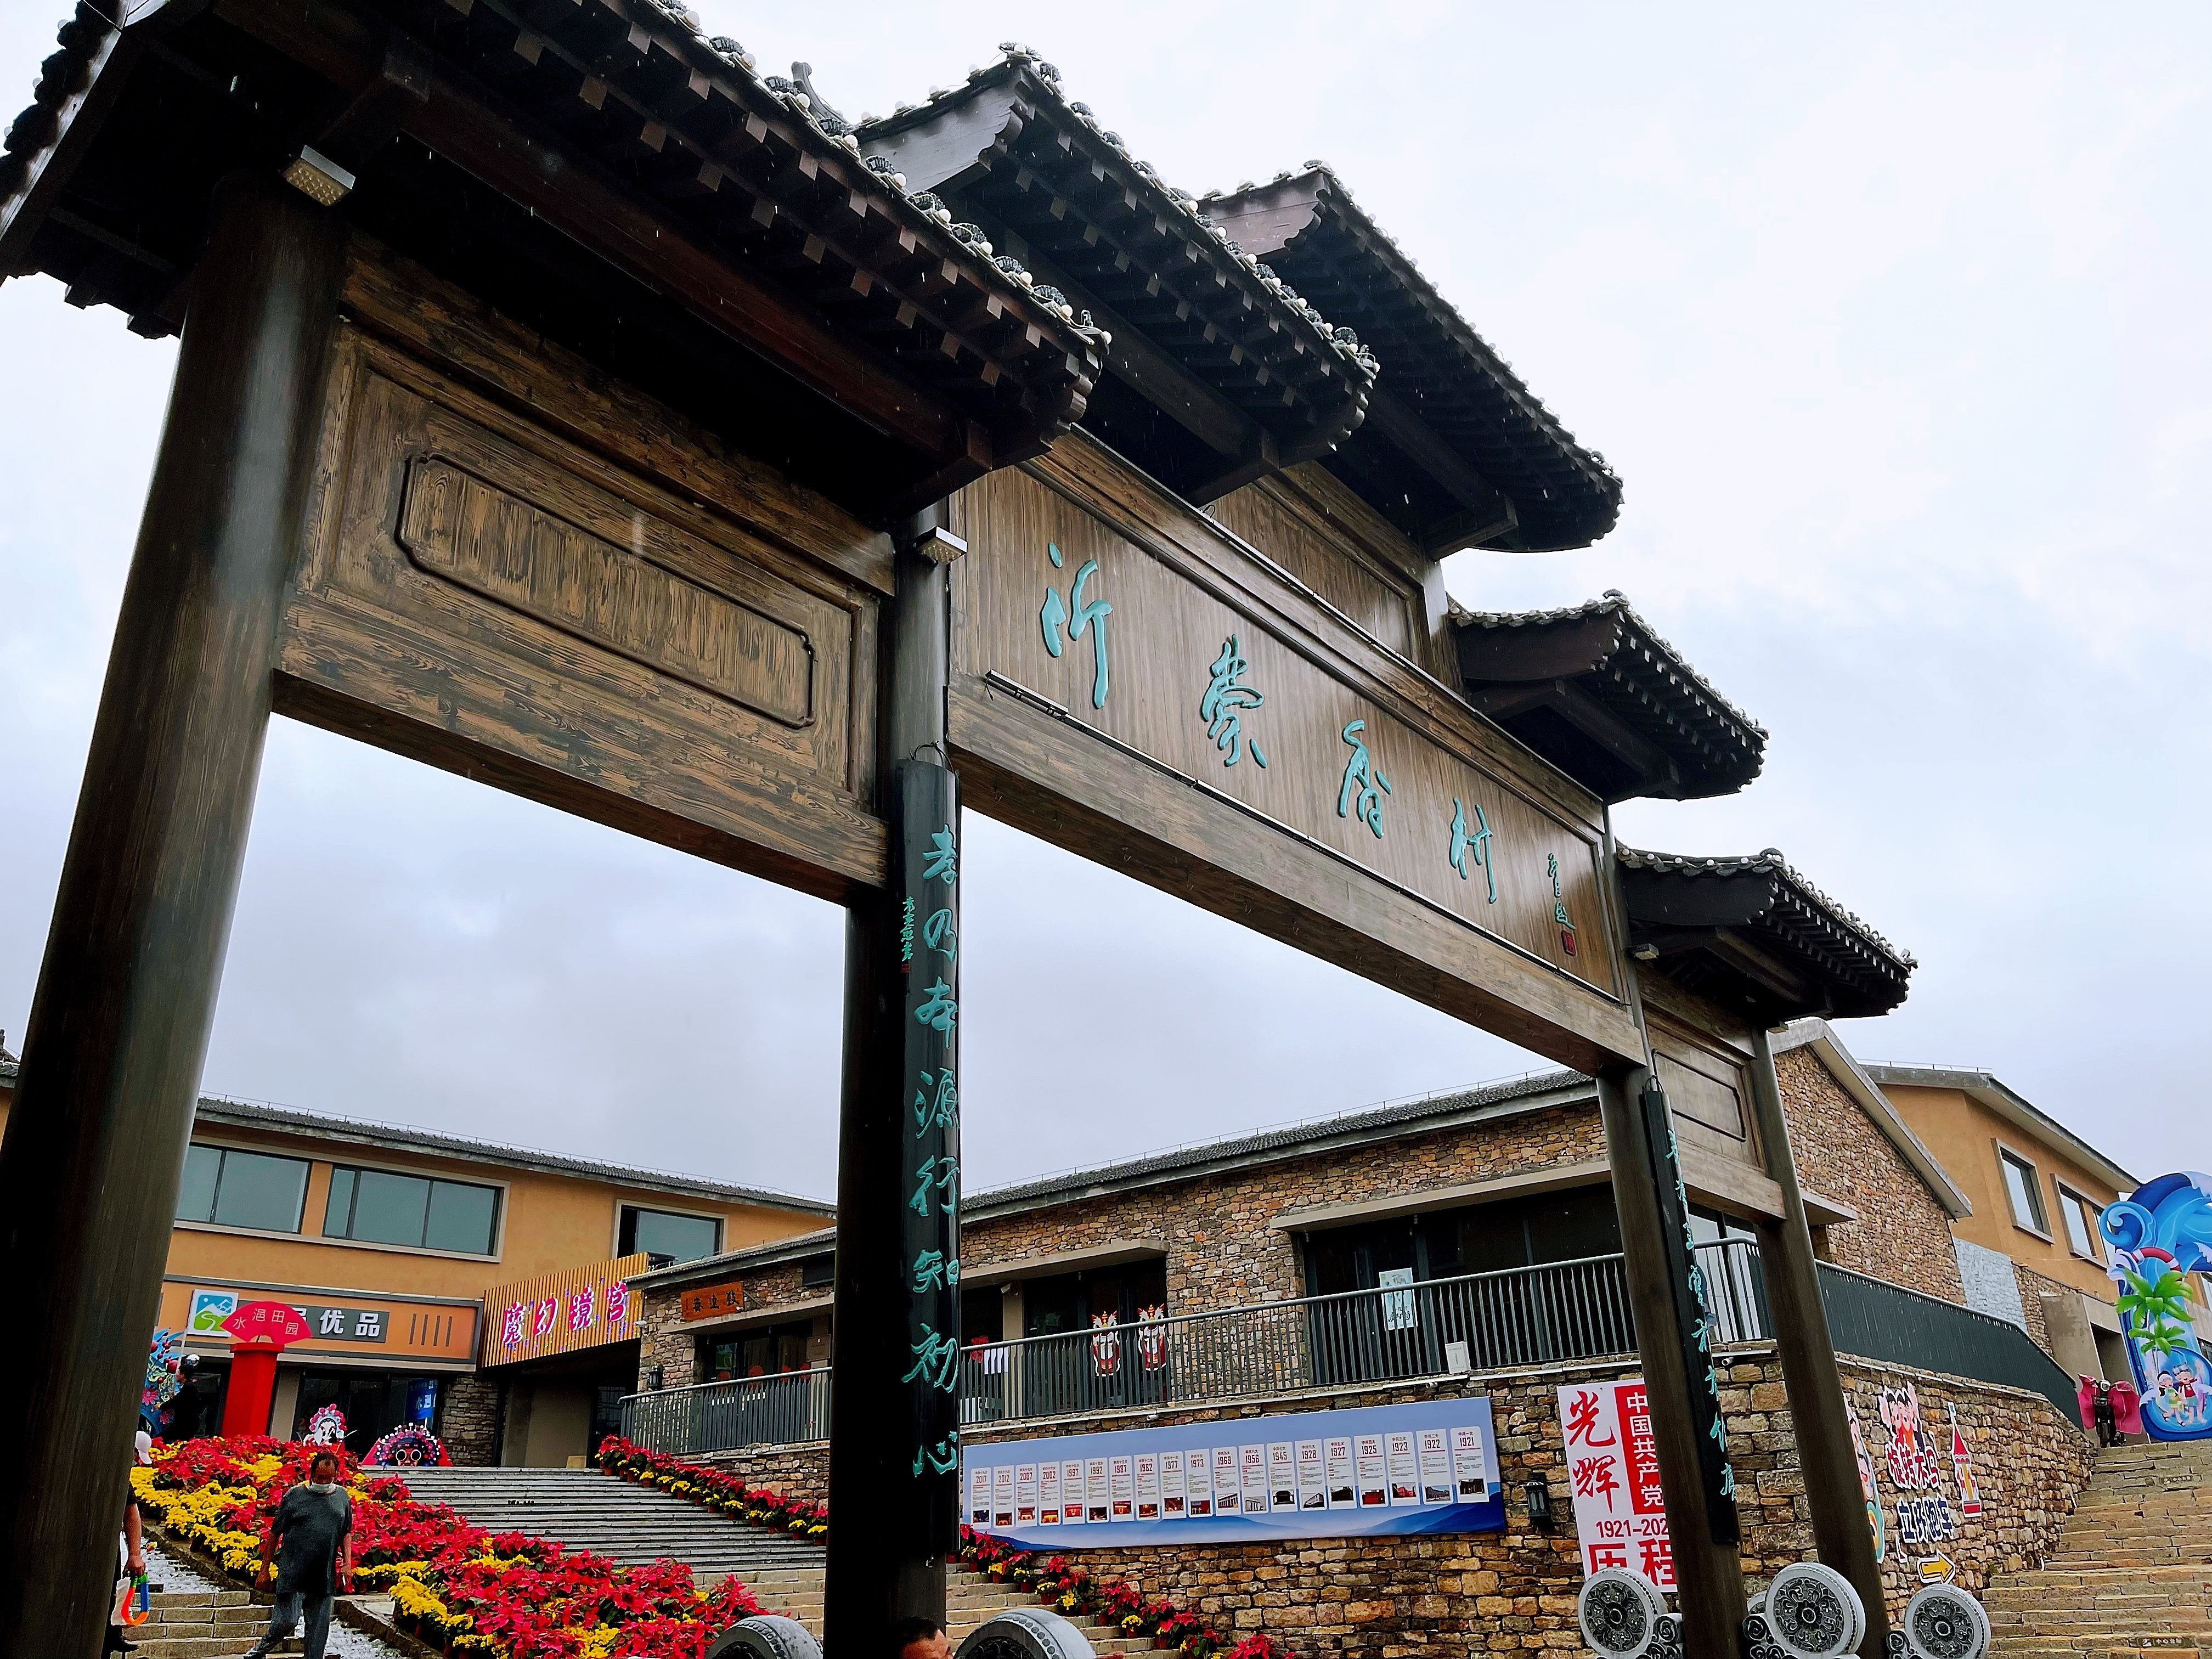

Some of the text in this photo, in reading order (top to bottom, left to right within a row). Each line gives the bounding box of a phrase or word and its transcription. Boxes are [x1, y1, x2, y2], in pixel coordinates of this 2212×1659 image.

[501, 1281, 628, 1345] 魔幻镜宫
[1425, 1439, 1440, 1449] 1922
[1459, 1437, 1474, 1447] 1921
[1331, 1447, 1345, 1456] 1927
[1362, 1445, 1377, 1454] 1925
[1392, 1442, 1408, 1452] 1923
[1627, 1392, 1664, 1507] 中国共产党
[1273, 1452, 1287, 1460] 1945
[1302, 1450, 1317, 1459] 1928
[1565, 1390, 1620, 1514] 光辉
[1191, 1459, 1204, 1468] 1973
[1217, 1456, 1232, 1465] 1969
[1245, 1454, 1259, 1464] 1956
[1115, 1465, 1127, 1473] 1987
[1140, 1463, 1153, 1472] 1982
[1166, 1460, 1178, 1469] 1977
[1067, 1469, 1079, 1477] 1997
[1091, 1466, 1103, 1475] 1992
[976, 1475, 986, 1483] 2017
[998, 1475, 1009, 1483] 2012
[1020, 1472, 1032, 1481] 2007
[1043, 1471, 1056, 1480] 2002
[1596, 1517, 1669, 1538] 1921-202
